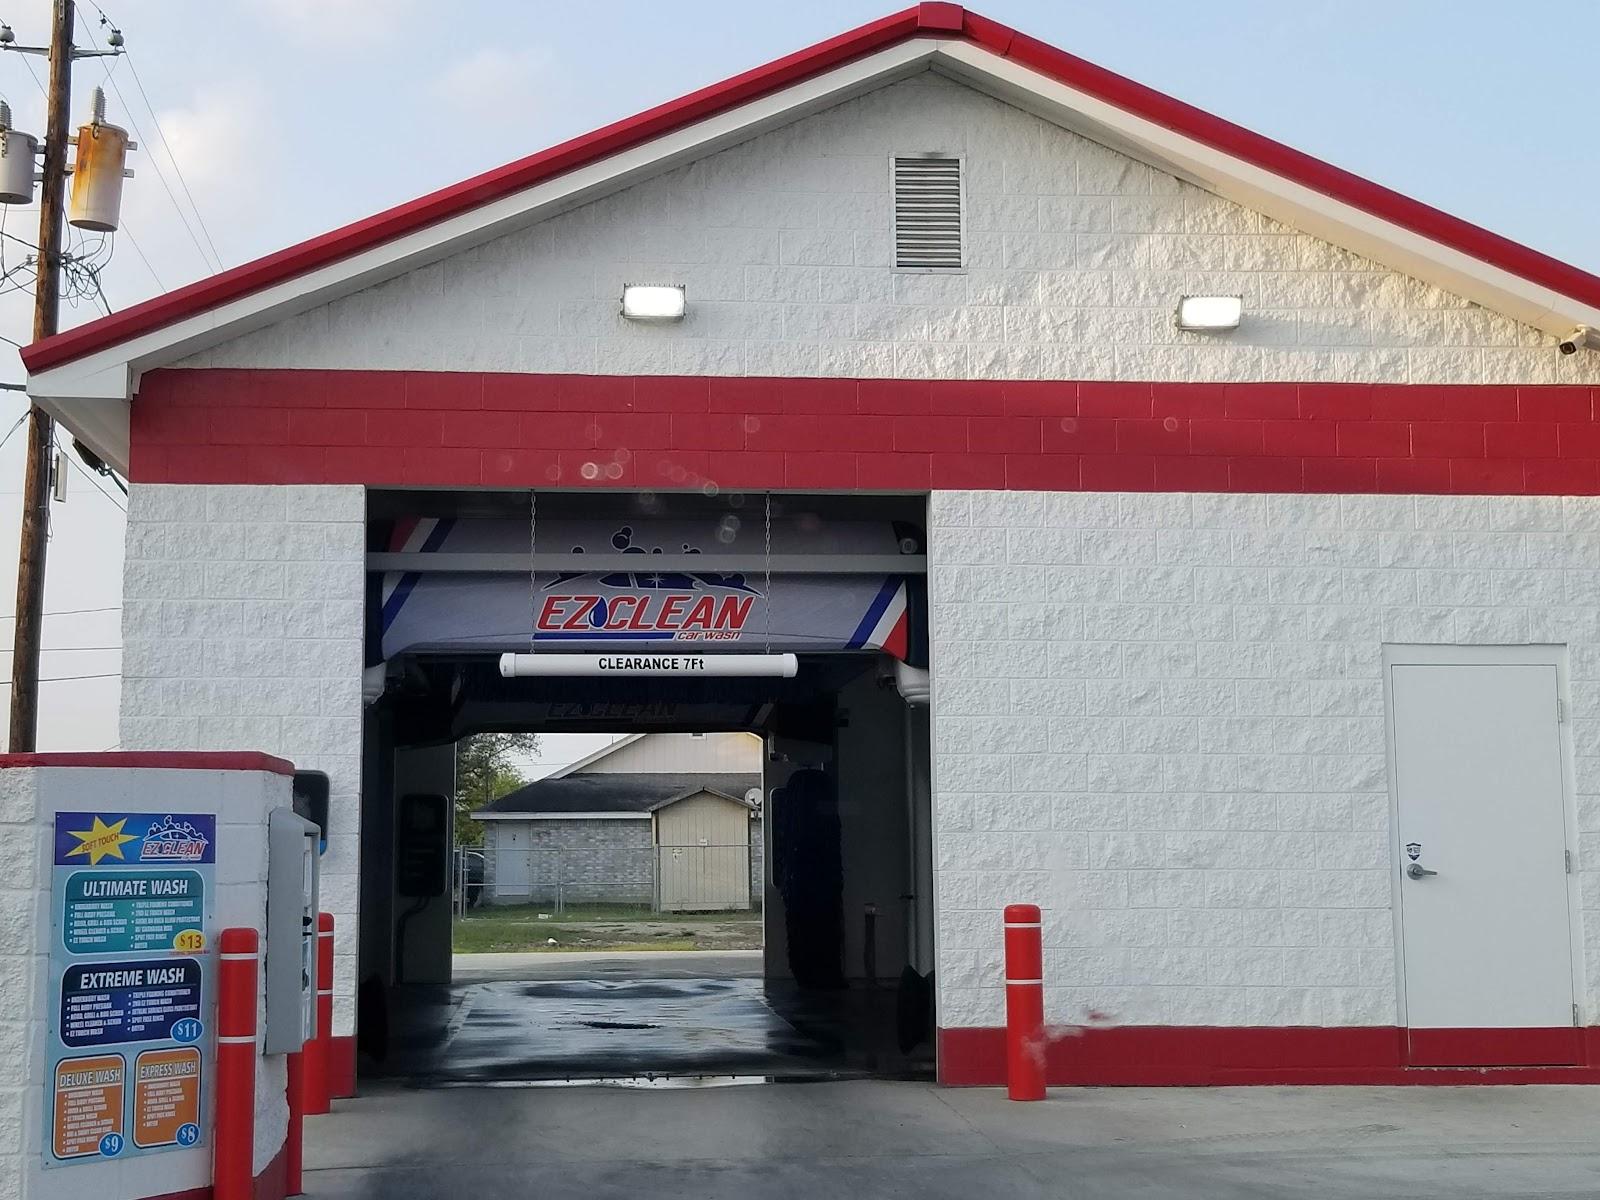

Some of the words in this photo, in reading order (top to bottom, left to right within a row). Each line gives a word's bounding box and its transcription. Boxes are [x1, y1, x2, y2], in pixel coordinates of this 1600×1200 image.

[604, 595, 755, 631] CLEAN
[598, 657, 679, 670] CLEARANCE
[683, 657, 705, 670] 7Ft
[97, 833, 119, 849] TOUCH
[83, 880, 147, 896] ULTIMATE
[151, 879, 188, 895] WASH
[180, 935, 202, 948] $13
[80, 969, 143, 989] EXTREME
[147, 967, 185, 985] WASH
[177, 1022, 197, 1037] $11
[60, 1072, 94, 1087] DELUXE
[95, 1069, 121, 1083] WASH
[140, 1063, 173, 1078] EXPRESS
[174, 1061, 196, 1075] WASH
[181, 1126, 195, 1142] $8
[105, 1135, 119, 1152] $9
